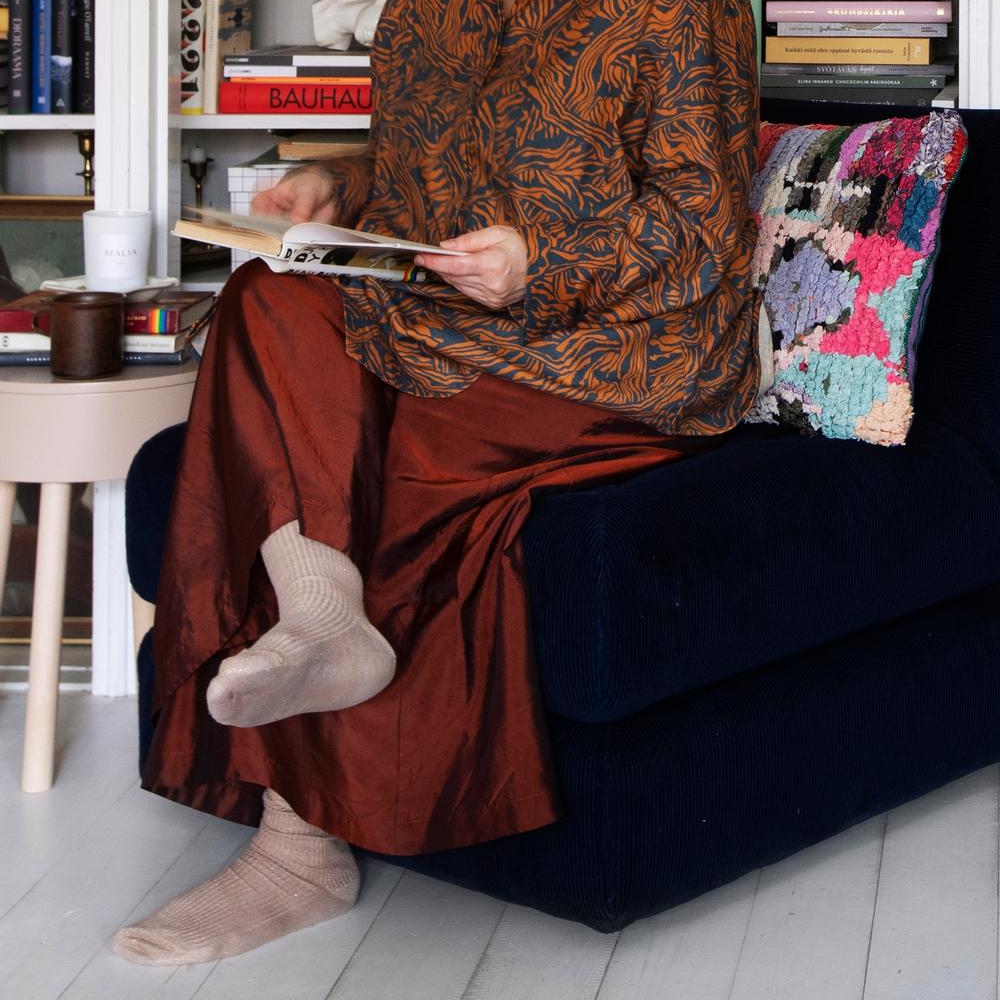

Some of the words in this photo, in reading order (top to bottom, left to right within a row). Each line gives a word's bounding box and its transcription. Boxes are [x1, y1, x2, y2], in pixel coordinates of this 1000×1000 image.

[12, 18, 22, 79] DIORAAMA
[831, 46, 850, 55] oppinut
[851, 46, 872, 54] hyvästä
[269, 88, 372, 110] BAUHAU
[104, 249, 138, 257] MALIA
